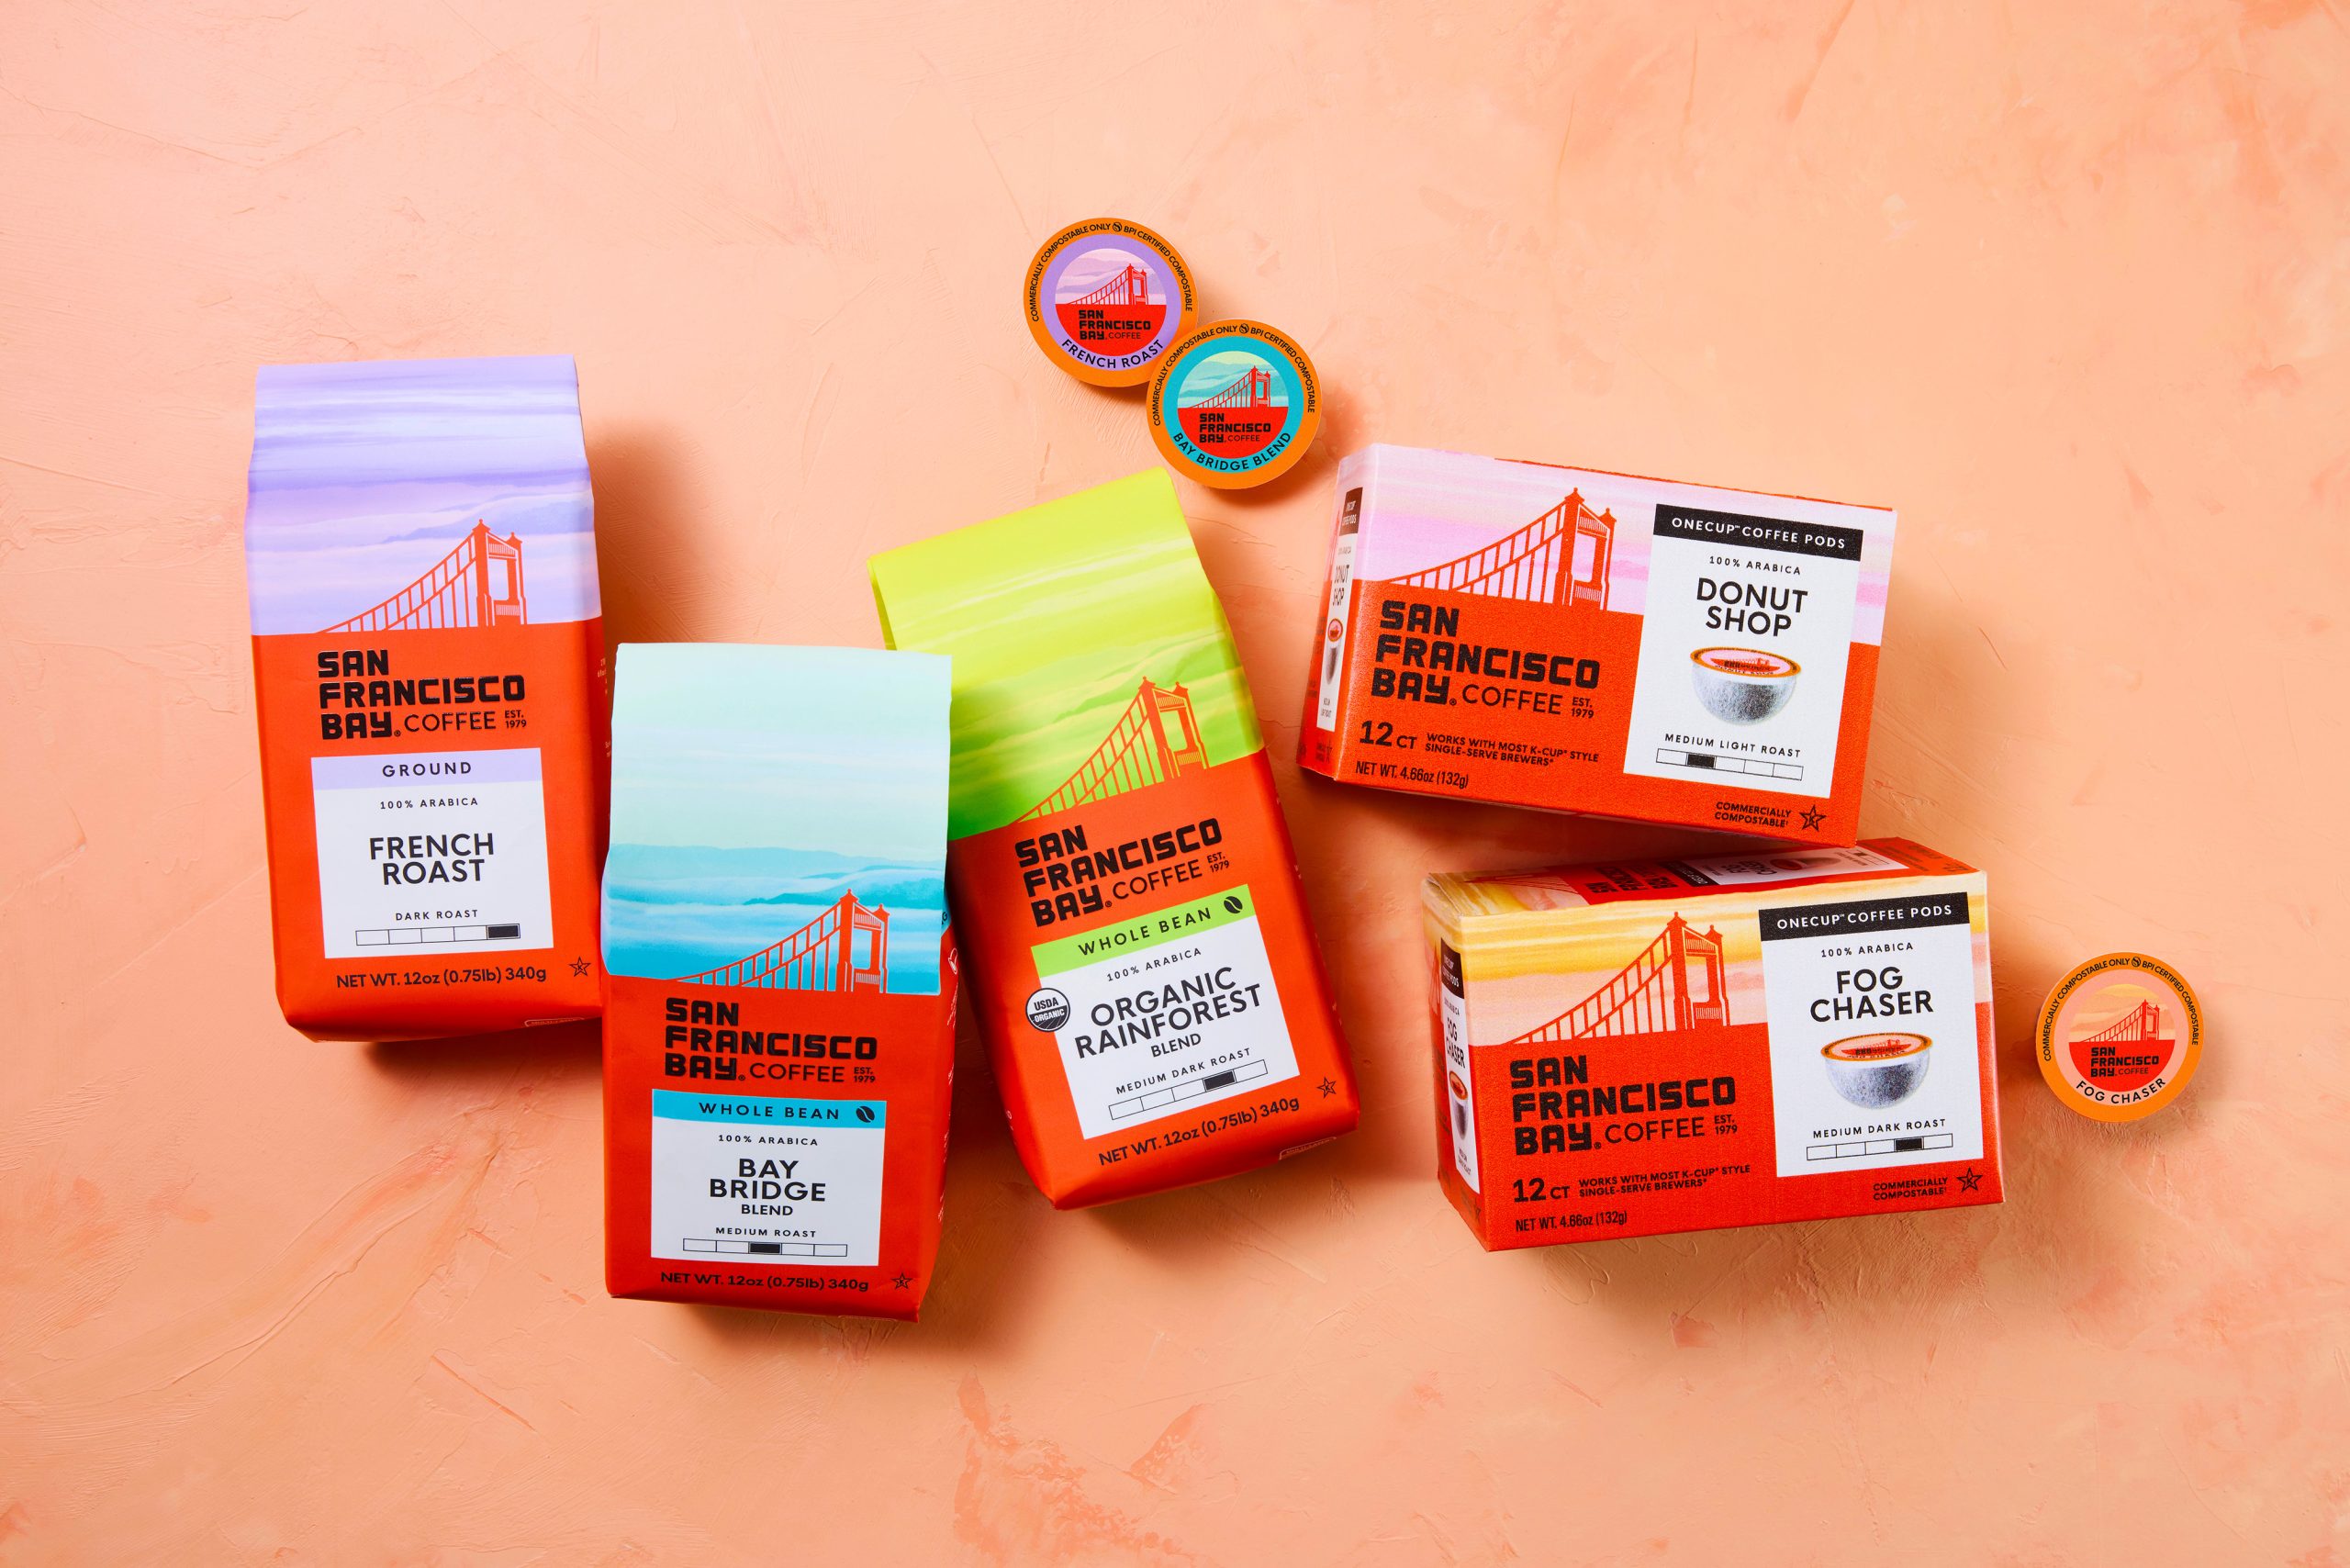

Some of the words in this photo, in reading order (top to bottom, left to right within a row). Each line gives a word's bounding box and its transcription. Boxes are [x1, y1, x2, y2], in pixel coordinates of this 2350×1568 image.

[1029, 263, 1044, 321] COMMERCIALLY
[1041, 226, 1089, 262] COMPOSTABLE
[1124, 226, 1136, 235] BPI
[1136, 231, 1170, 257] CERTIFIED
[1169, 256, 1192, 312] COMPOSTABLE
[1079, 310, 1103, 319] SAN
[1080, 320, 1151, 330] FRANCISCO
[1061, 339, 1116, 368] FRENCH
[1122, 340, 1164, 367] ROAST
[1153, 366, 1168, 426] COMMERCIALLY
[1166, 329, 1214, 366] COMPOSTABLE
[1251, 328, 1264, 336] BPI
[1264, 332, 1296, 358] CERTIFIED
[1294, 357, 1315, 413] COMPOSTABLE
[1200, 413, 1225, 422] SAN
[1200, 423, 1270, 432] FRANCISCO
[1173, 433, 1196, 455] BAY
[1196, 454, 1249, 471] BRIDGE
[1254, 432, 1291, 465] BLEND
[1742, 526, 1798, 543] COFFEE
[1805, 534, 1845, 549] PODS
[1709, 555, 1740, 567] 100%
[1746, 560, 1801, 575] ARABICA
[1696, 577, 1808, 613] DONUT
[1380, 600, 1460, 637] SAN
[1706, 606, 1792, 636] SHOP
[318, 650, 389, 678] SAN
[1375, 634, 1600, 689] FRANCISCO
[319, 675, 525, 709] FRANCISCO
[1462, 684, 1563, 715] COFFEE
[404, 711, 497, 733] COFFEE
[505, 719, 527, 728] 1979
[1572, 707, 1595, 719] 1979
[1360, 721, 1393, 747] 12
[1396, 735, 1417, 749] CT
[1665, 734, 1715, 747] MEDIUM
[1719, 740, 1755, 752] LIGHT
[1761, 745, 1801, 757] ROAST
[1426, 743, 1497, 759] SINGLE-SERVE
[1427, 734, 1466, 745] WORKS
[1469, 737, 1495, 750] WITH
[1498, 743, 1528, 754] MOST
[1570, 751, 1599, 762] STYLE
[382, 761, 472, 778] GROUND
[1356, 761, 1377, 775] NET
[1400, 767, 1434, 782] 4.66oz
[1437, 770, 1469, 789] (132g)
[380, 800, 413, 810] 100%
[420, 798, 478, 809] ARABICA
[1716, 801, 1791, 818] COMMERCIALLY
[369, 833, 494, 860] FRENCH
[1015, 824, 1088, 868] SAN
[1023, 818, 1222, 897] FRANCISCO
[383, 859, 485, 885] ROAST
[1209, 859, 1230, 873] 1979
[1112, 859, 1203, 901] COFFEE
[396, 911, 430, 921] DARK
[436, 910, 477, 919] ROAST
[1847, 909, 1904, 924] COFFEE
[1911, 905, 1952, 918] PODS
[1078, 925, 1150, 956] WHOLE
[1158, 908, 1212, 933] BEAN
[1820, 947, 1852, 958] 100%
[1858, 943, 1913, 954] ARABICA
[1106, 966, 1140, 981] 100%
[1145, 947, 1202, 970] ARABICA
[337, 974, 367, 988] NET
[404, 971, 440, 986] 12oz
[443, 969, 501, 985] (0.75lb)
[505, 967, 546, 983] 340g
[1836, 967, 1903, 994] FOG
[1034, 997, 1058, 1011] USDA
[1091, 967, 1237, 1026] ORGANIC
[1810, 991, 1933, 1023] CHASER
[666, 998, 739, 1026] SAN
[1034, 1008, 1065, 1023] ORGANIC
[1074, 983, 1261, 1058] RAINFOREST
[2043, 999, 2060, 1061] COMMERCIALLY
[2057, 961, 2108, 1000] COMPOSTABLE
[2143, 961, 2154, 970] BPI
[2154, 966, 2184, 991] CERTIFIED
[2182, 991, 2199, 1046] COMPOSTABLE
[666, 1025, 877, 1060] FRANCISCO
[1150, 1033, 1202, 1058] BLEND
[2091, 1047, 2115, 1056] SAN
[749, 1063, 845, 1082] COFFEE
[1116, 1073, 1167, 1094] MEDIUM
[1171, 1061, 1205, 1080] DARK
[1211, 1047, 1251, 1069] ROAST
[1510, 1055, 1588, 1089] SAN
[2091, 1056, 2159, 1067] FRANCISCO
[854, 1075, 876, 1083] 1979
[2076, 1081, 2105, 1101] FOG
[2111, 1078, 2165, 1103] CHASER
[1513, 1076, 1736, 1122] FRANCISCO
[699, 1103, 773, 1117] WHOLE
[785, 1107, 839, 1120] BEAN
[1099, 1148, 1129, 1166] NET
[1163, 1126, 1199, 1148] 12oz
[1202, 1108, 1259, 1139] (0.75lb)
[1259, 1095, 1300, 1123] 340g
[1605, 1117, 1705, 1144] COFFEE
[1715, 1125, 1738, 1135] 1979
[1813, 1126, 1863, 1138] MEDIUM
[1868, 1123, 1901, 1134] DARK
[1906, 1119, 1946, 1130] ROAST
[719, 1135, 752, 1143] 100%
[759, 1136, 818, 1146] ARABICA
[739, 1159, 799, 1179] BAY
[1579, 1176, 1617, 1187] WORKS
[1620, 1174, 1647, 1183] WITH
[1651, 1171, 1679, 1181] MOST
[1722, 1165, 1751, 1174] STYLE
[710, 1179, 826, 1202] BRIDGE
[1513, 1178, 1546, 1202] 12
[1550, 1186, 1570, 1199] CT
[1580, 1183, 1651, 1197] SINGLE-SERVE
[1873, 1177, 1948, 1191] COMMERCIALLY
[741, 1204, 793, 1215] BLEND
[716, 1227, 768, 1236] MEDIUM
[774, 1229, 816, 1238] ROAST
[1516, 1218, 1536, 1232] NET
[1561, 1215, 1593, 1227] 4.66oz
[1595, 1211, 1628, 1226] (132g)
[661, 1271, 692, 1283] NET
[728, 1274, 764, 1286] 12oz
[767, 1275, 824, 1289] (0.75lb)
[828, 1278, 868, 1292] 340g
